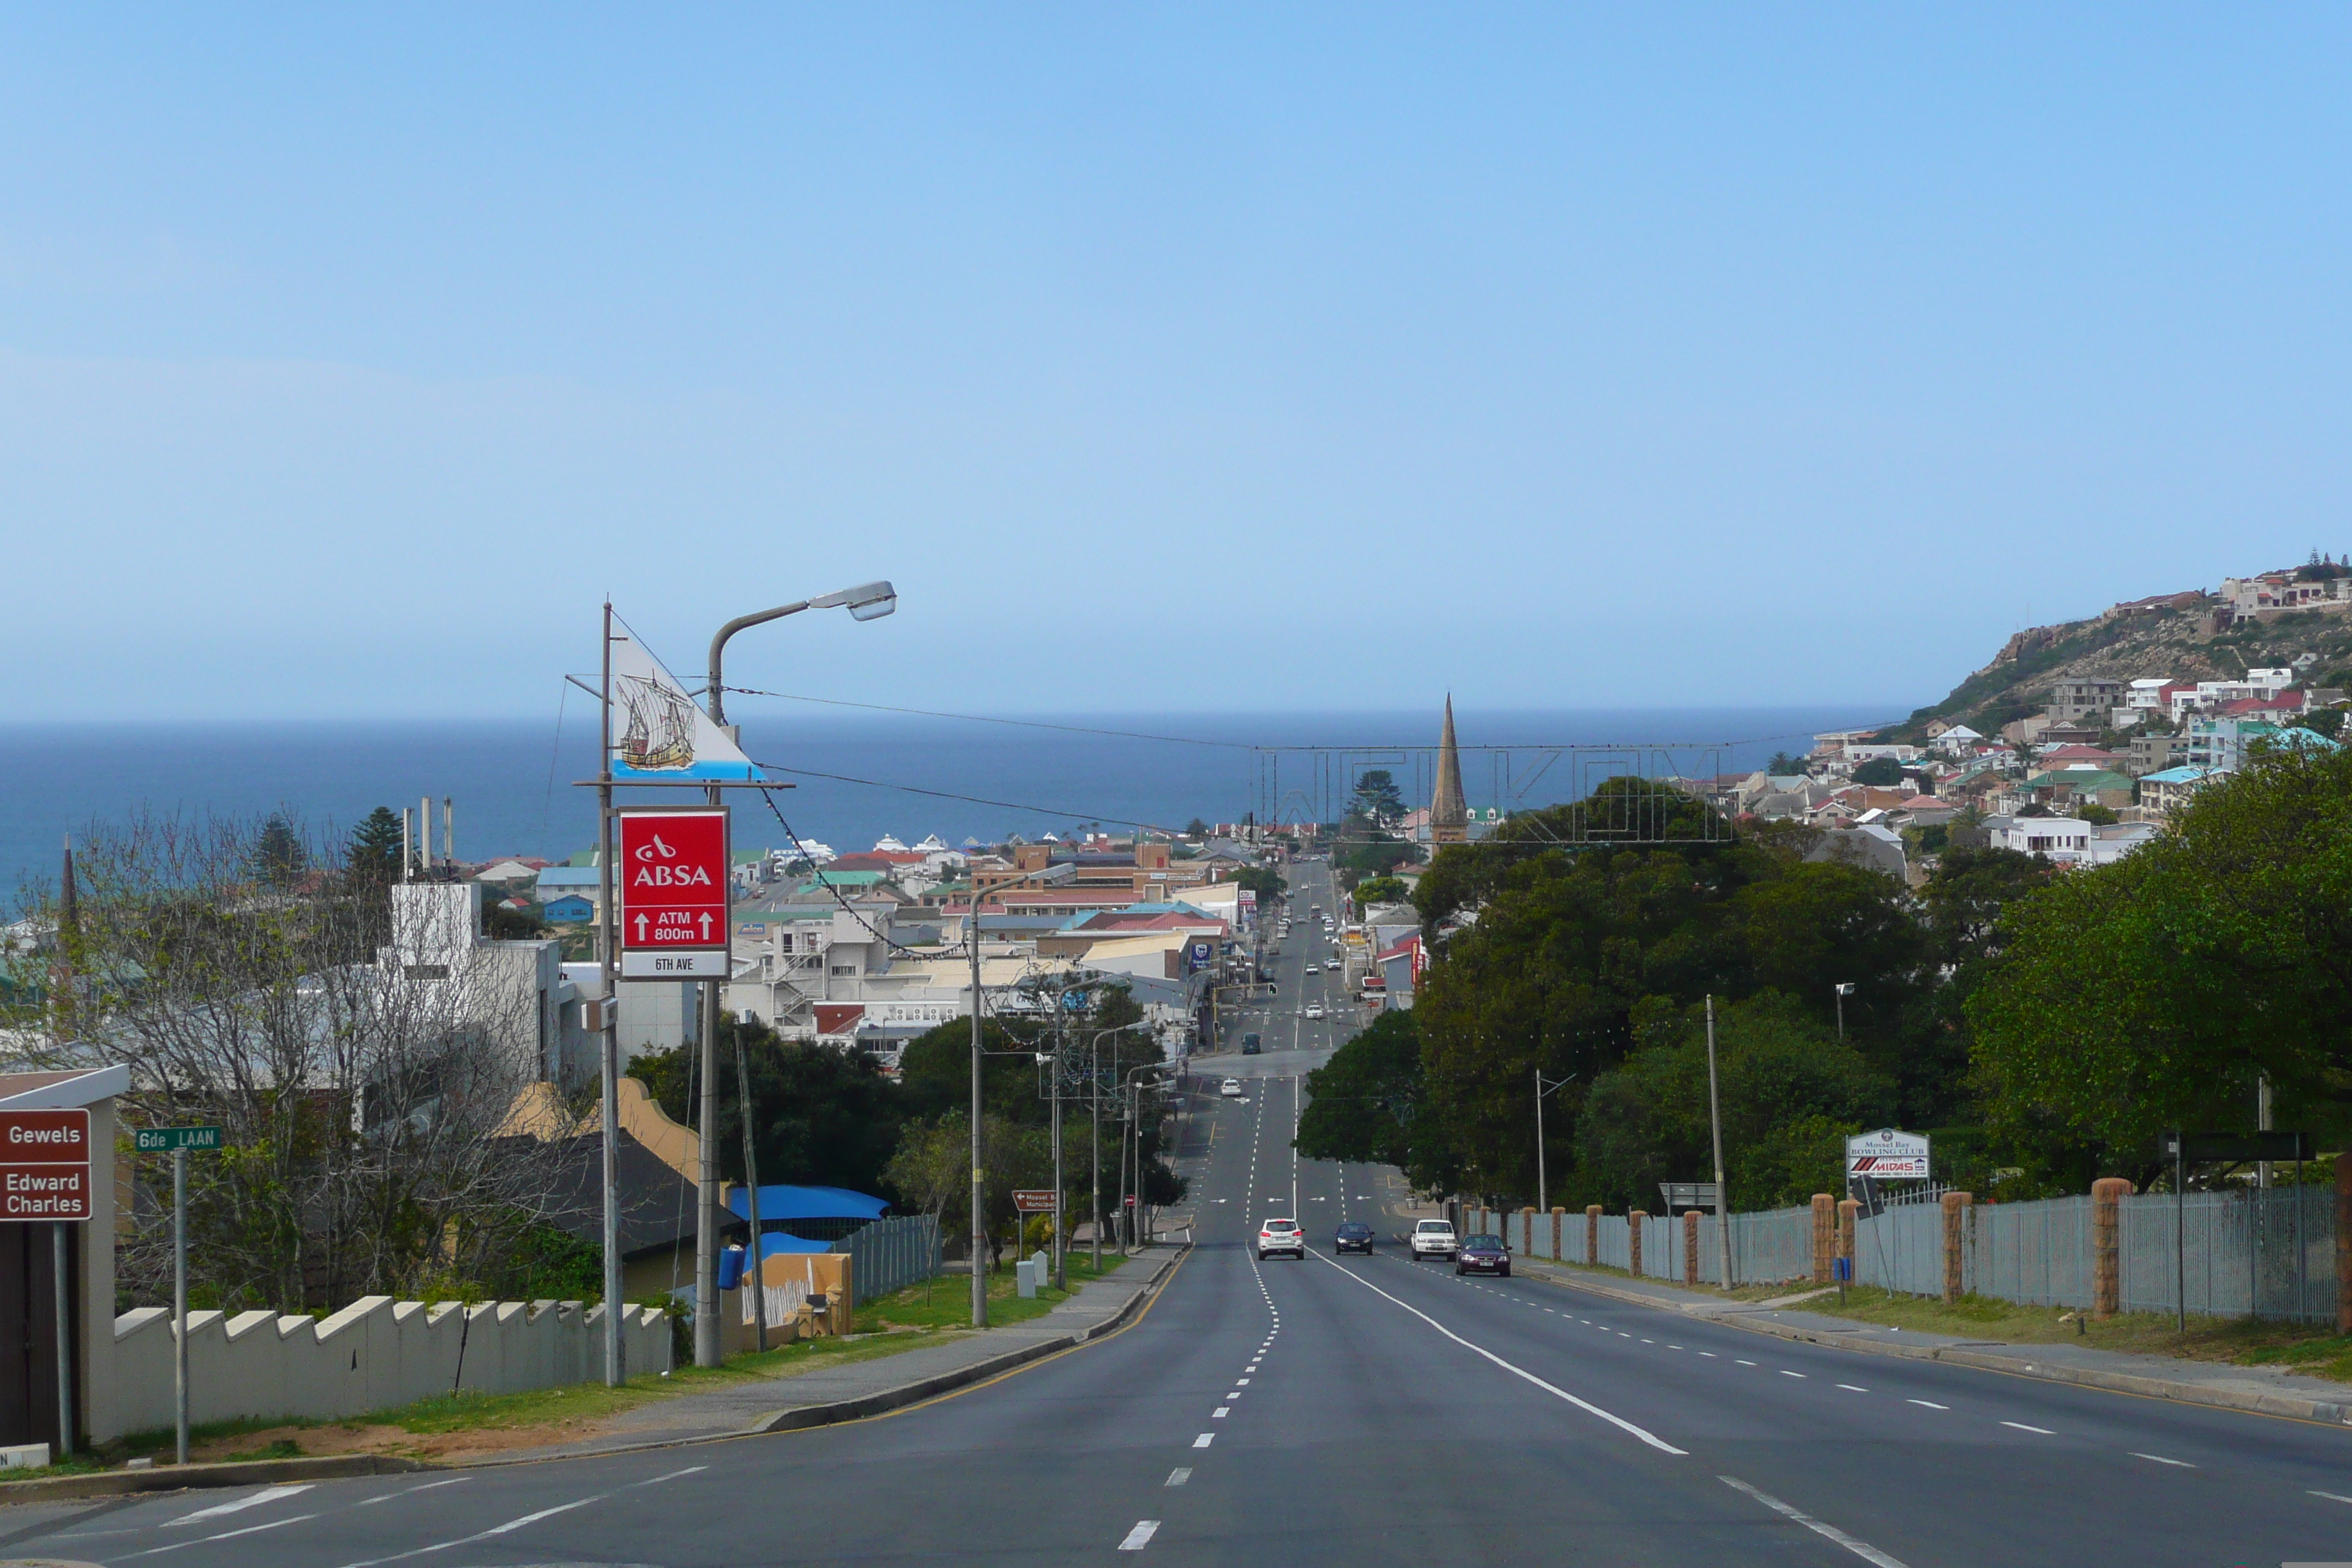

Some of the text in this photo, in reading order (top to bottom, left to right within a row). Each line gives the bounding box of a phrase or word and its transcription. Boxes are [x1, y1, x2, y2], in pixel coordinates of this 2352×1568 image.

[633, 865, 712, 886] ABSA
[657, 911, 690, 924] ATM
[655, 927, 694, 941] 800m
[655, 958, 693, 970] 6TH AVE
[10, 1126, 80, 1143] Gewels
[139, 1130, 214, 1147] 6de LAAN
[1895, 1141, 1910, 1149] Bay
[1872, 1162, 1914, 1171] MIDAS
[7, 1173, 79, 1191] Edward
[7, 1195, 82, 1213] Charles
